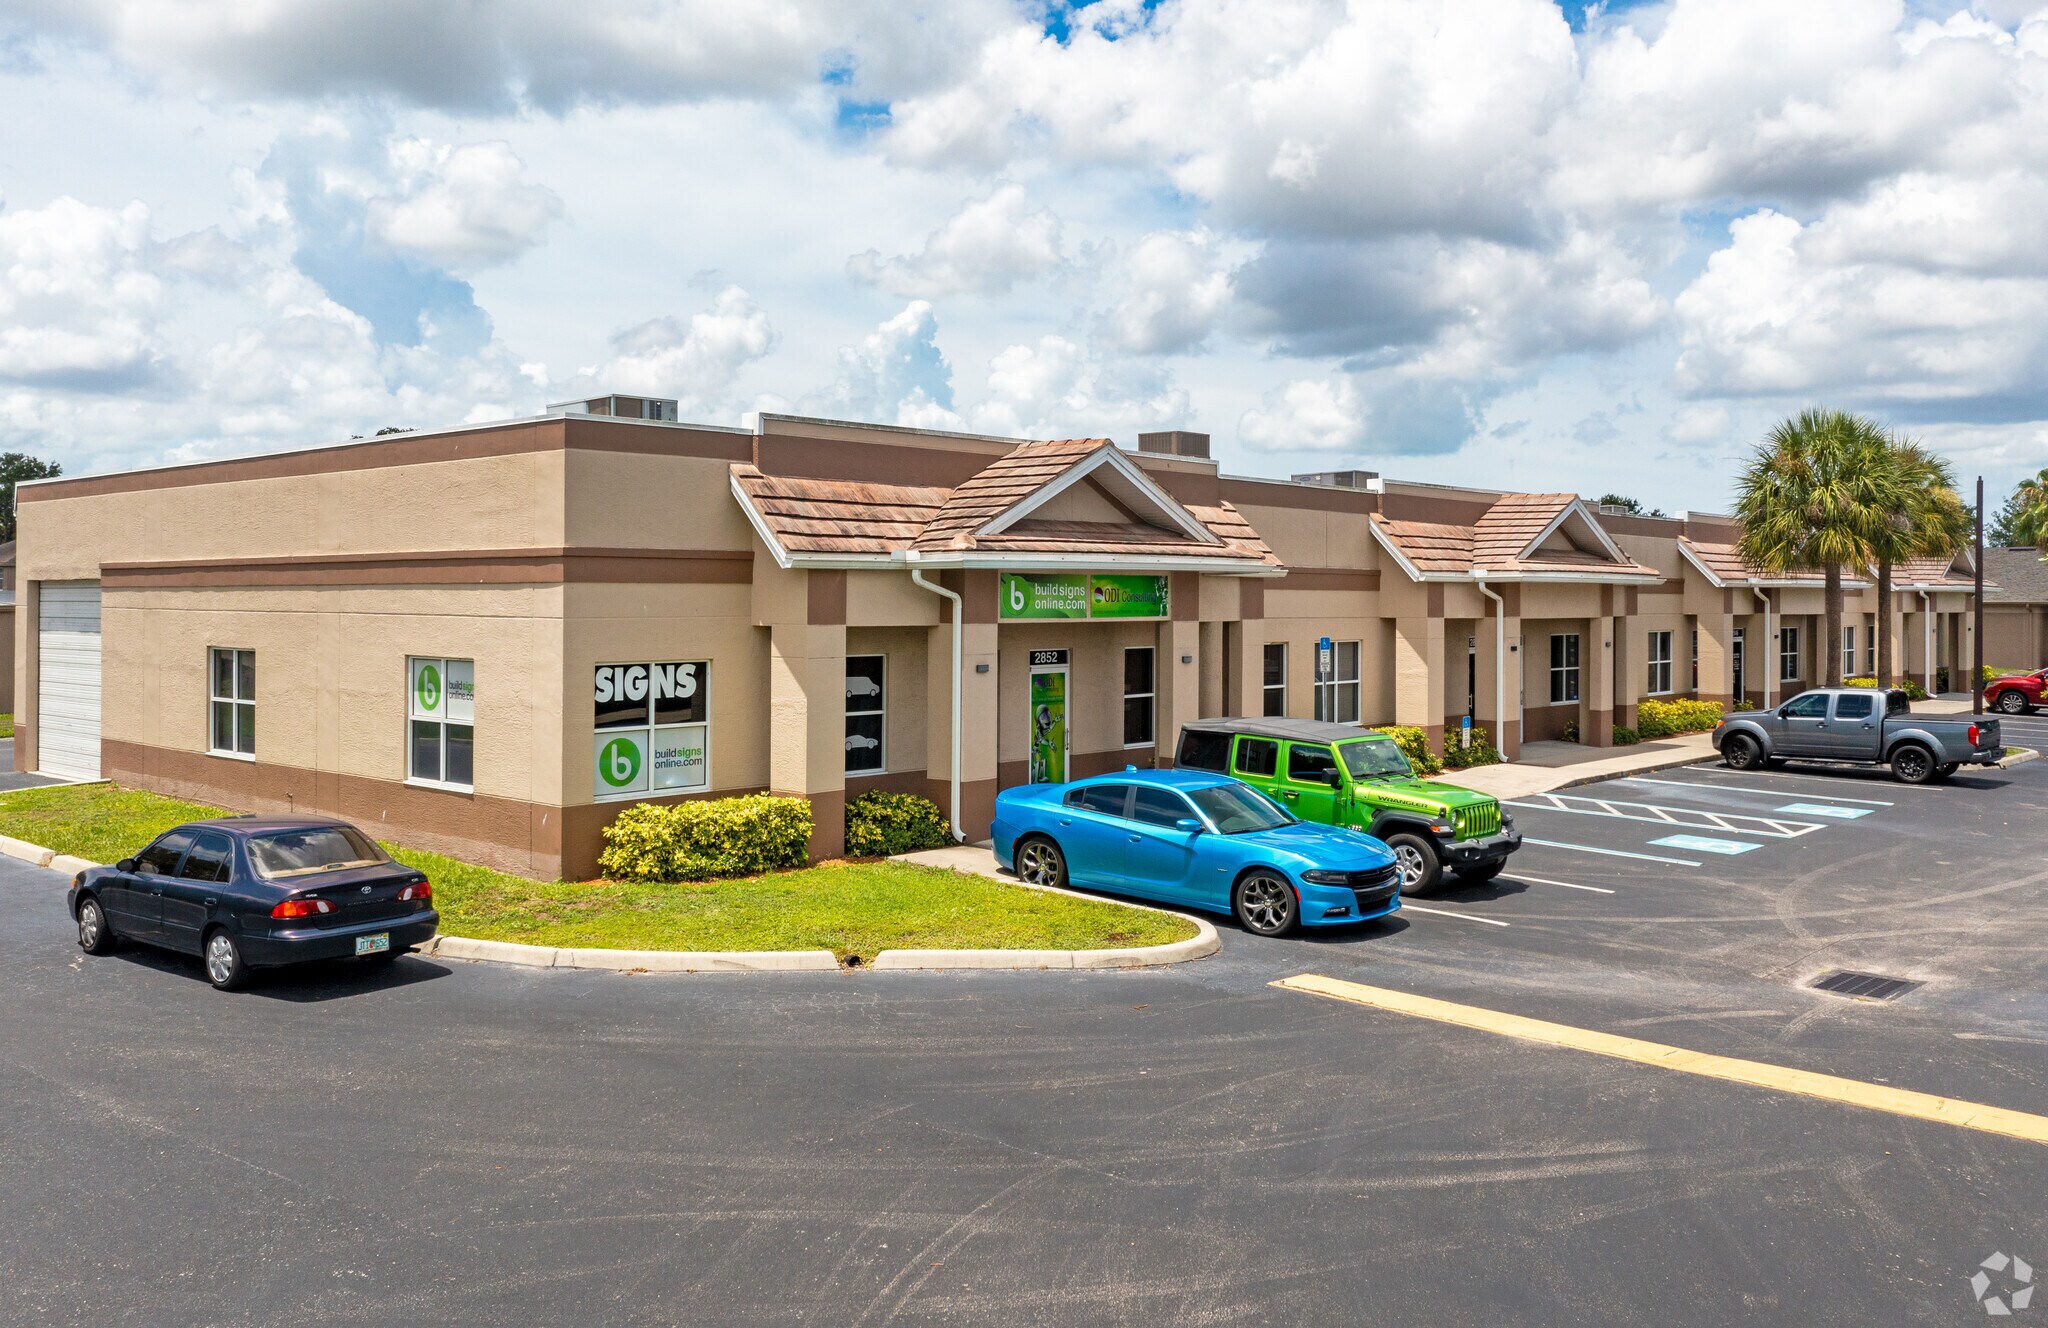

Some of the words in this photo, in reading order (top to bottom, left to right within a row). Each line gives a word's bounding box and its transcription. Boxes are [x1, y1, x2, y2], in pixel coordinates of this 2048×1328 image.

[1104, 587, 1120, 603] ODI
[1034, 598, 1086, 610] online.com
[1034, 652, 1058, 664] 2852
[594, 663, 697, 703] SIGNS
[654, 758, 703, 769] online.com
[1377, 795, 1428, 808] WRANGLER
